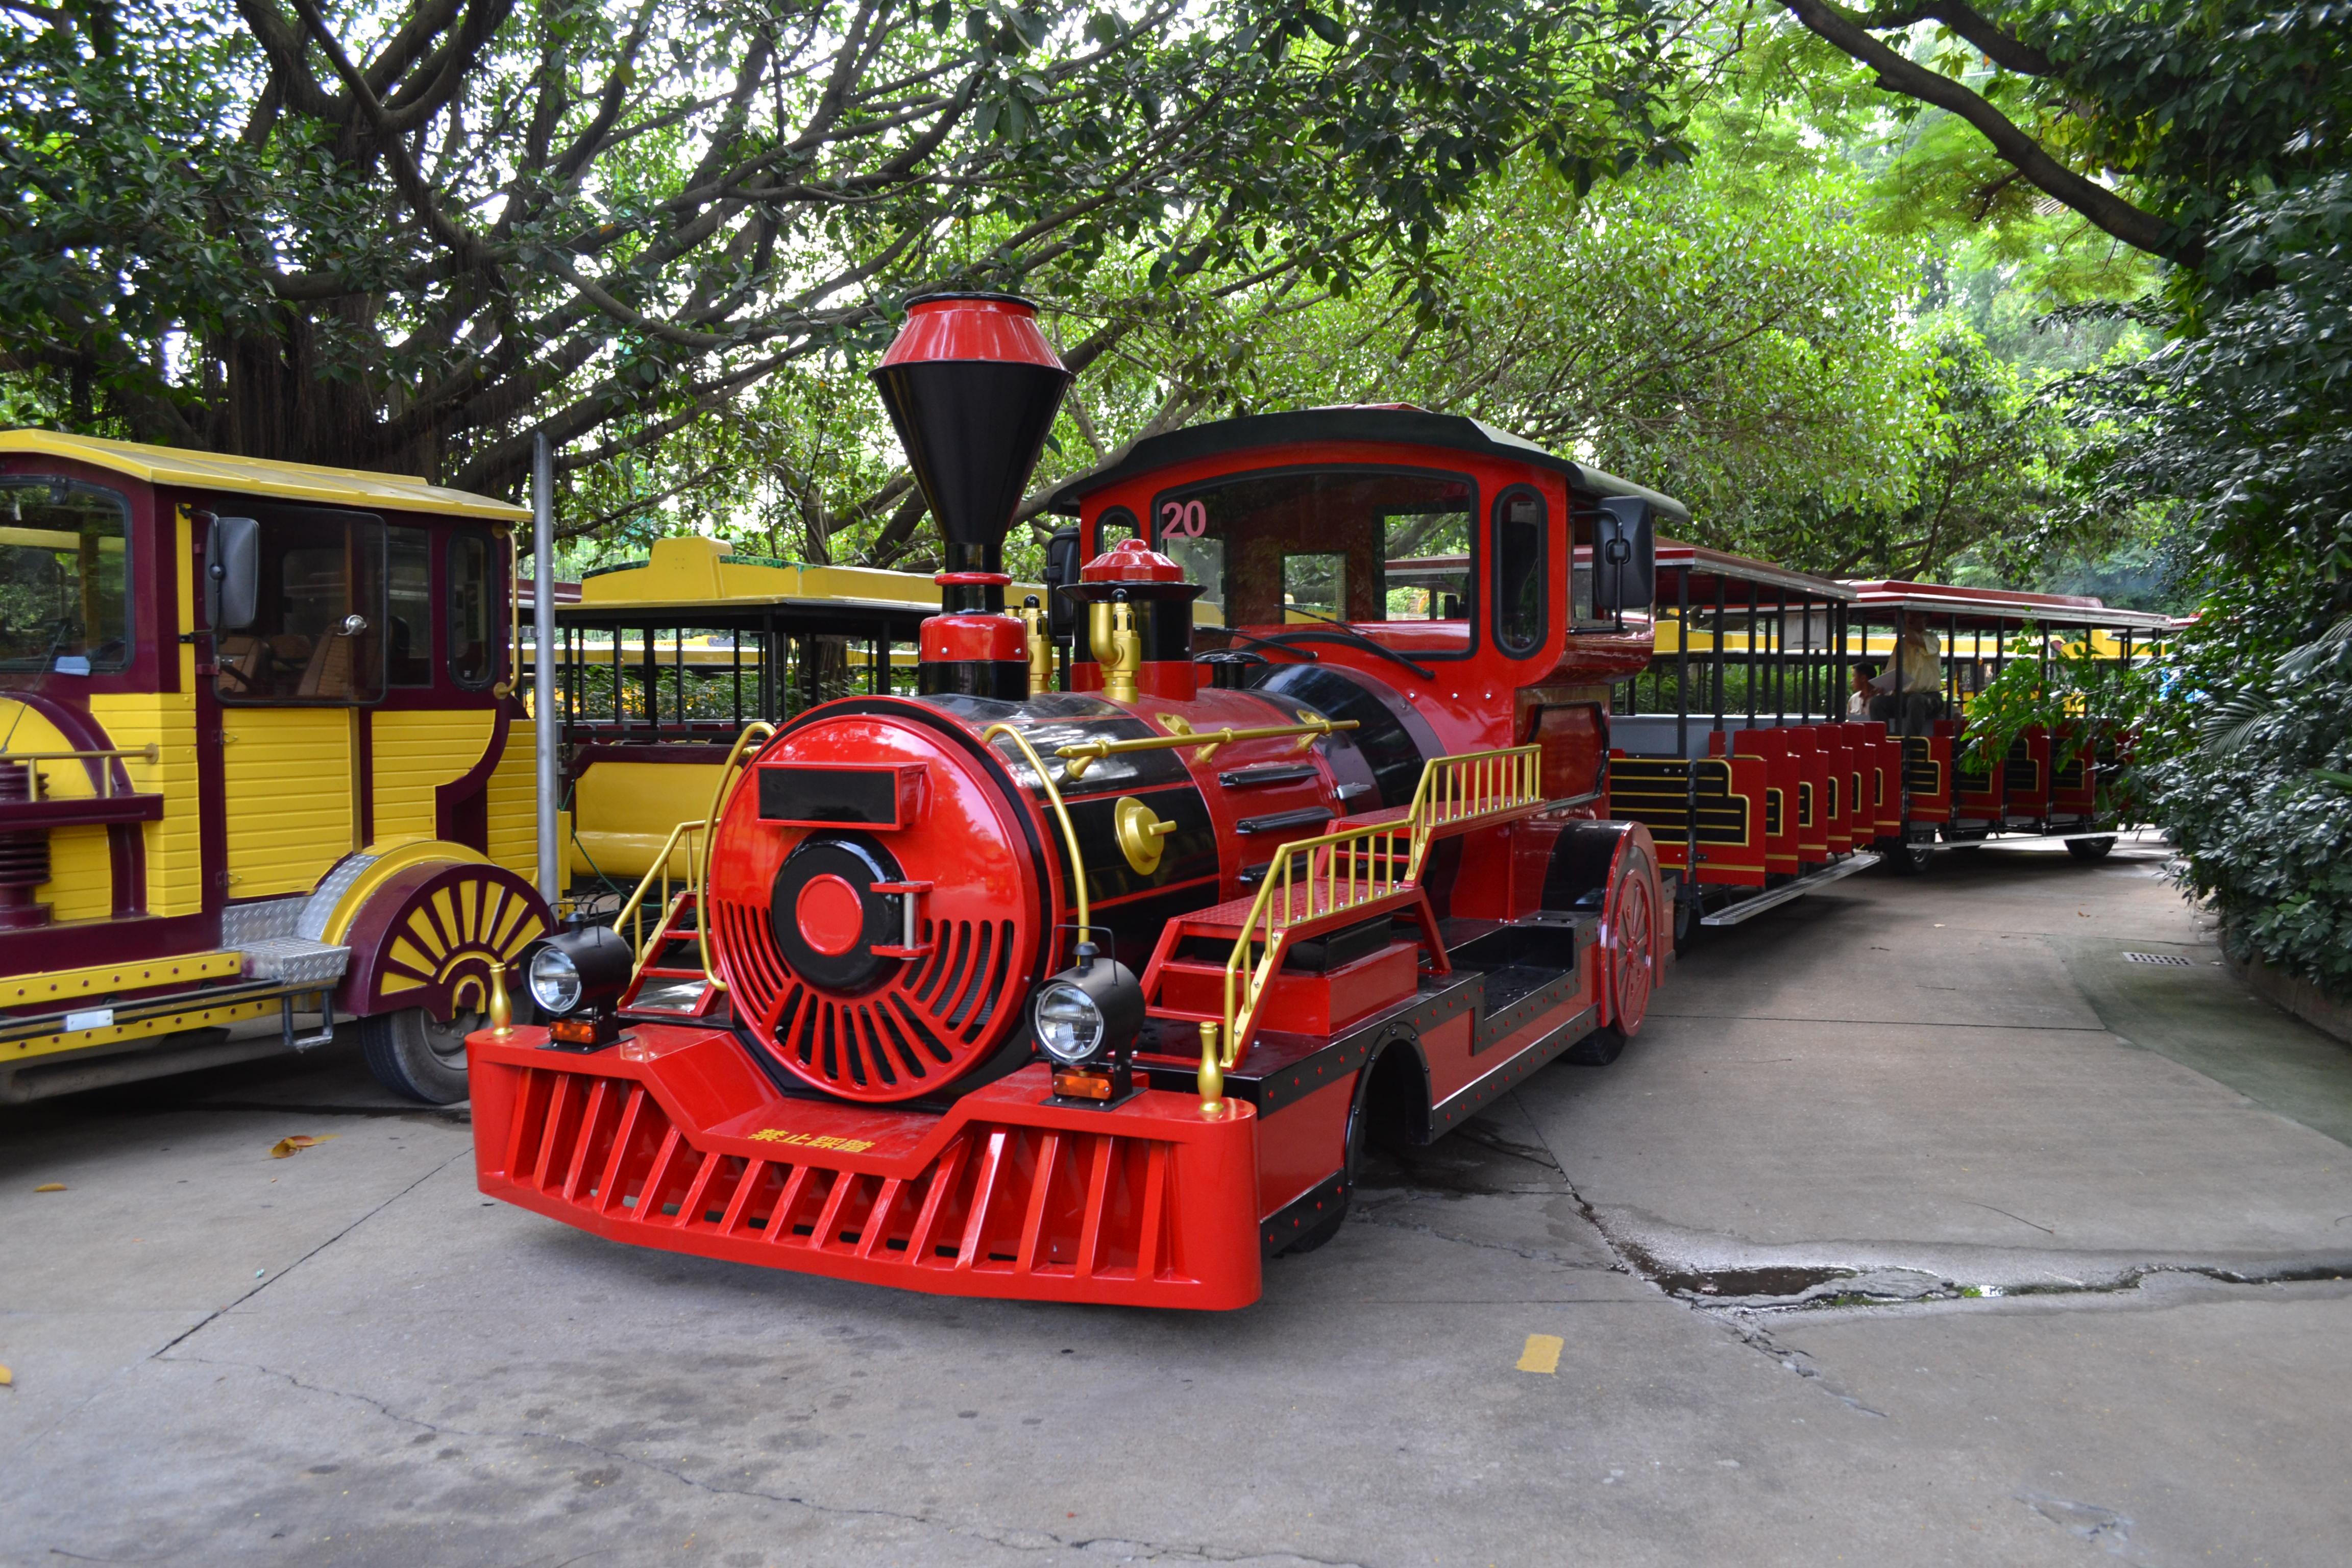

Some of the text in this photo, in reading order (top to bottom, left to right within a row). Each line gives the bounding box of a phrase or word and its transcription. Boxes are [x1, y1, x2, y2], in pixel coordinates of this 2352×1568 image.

[1161, 500, 1207, 539] 20
[748, 1129, 875, 1153] 禁止踩踏
